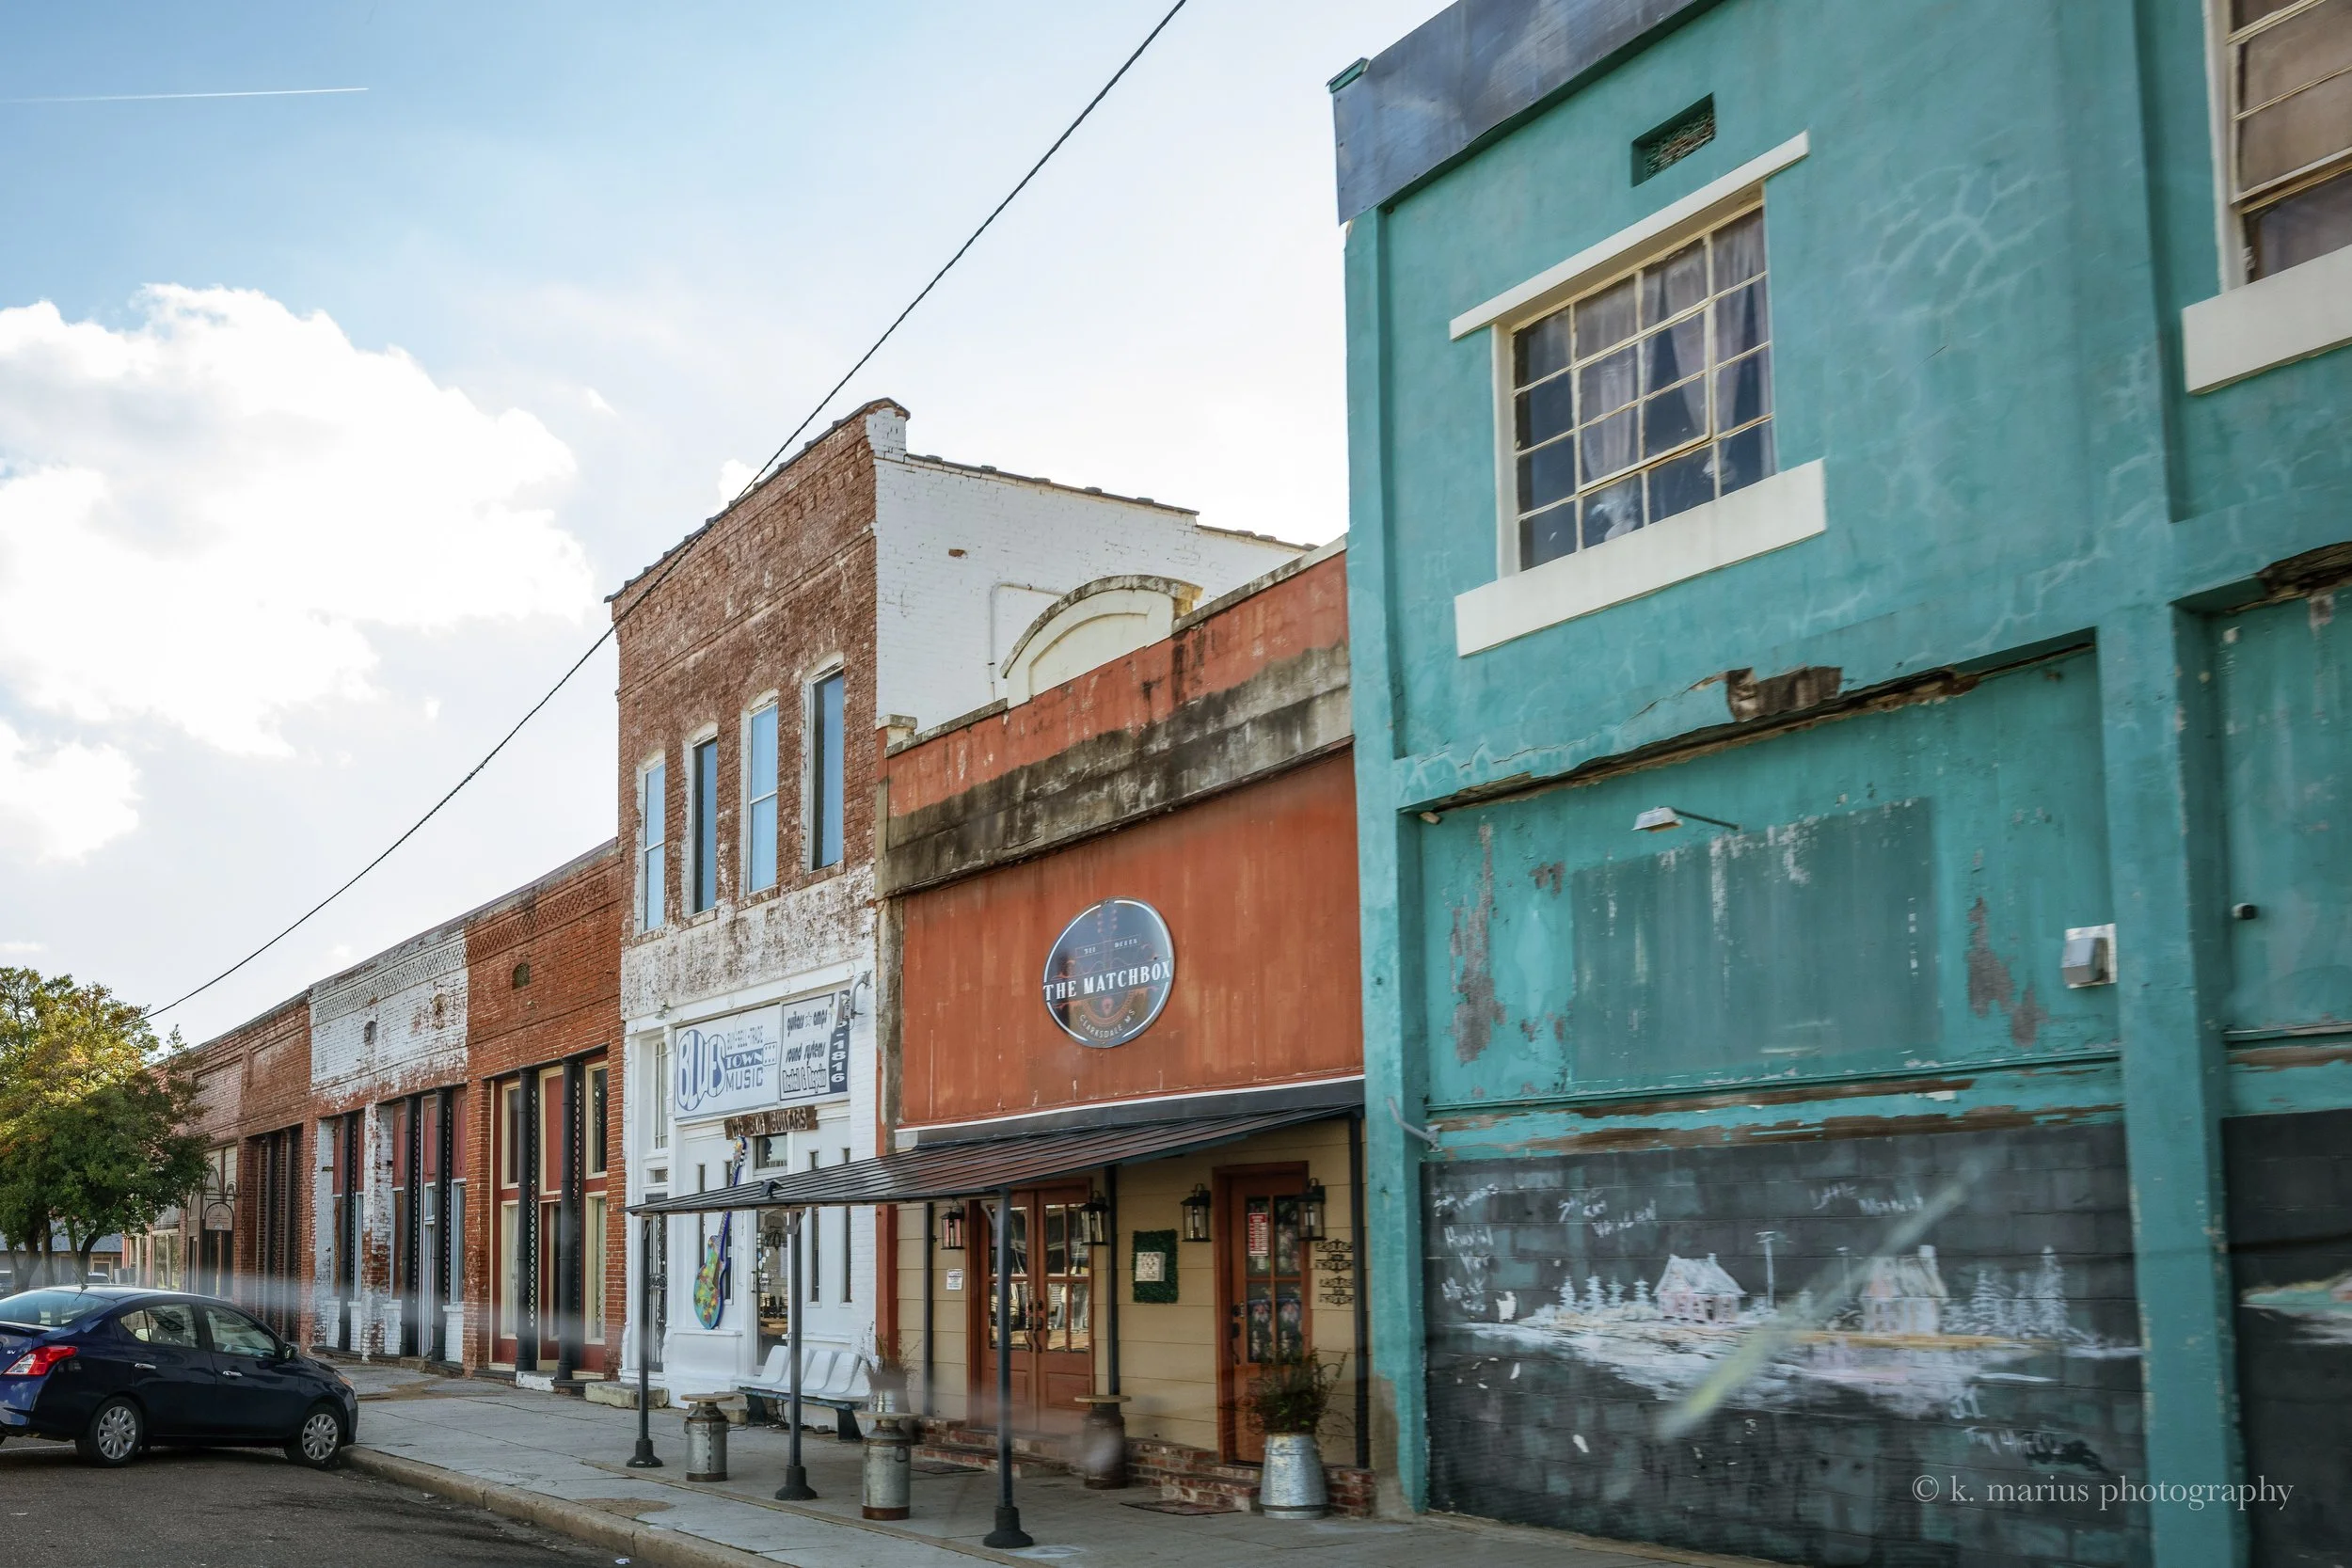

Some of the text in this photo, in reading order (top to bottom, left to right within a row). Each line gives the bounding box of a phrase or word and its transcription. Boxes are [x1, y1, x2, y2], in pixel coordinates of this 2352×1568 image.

[1043, 960, 1170, 1002] THE MATCHBOX
[1079, 1014, 1123, 1038] CLARKSDALE
[677, 1029, 726, 1111] BLUES
[725, 1052, 763, 1069] TOWN
[725, 1067, 763, 1092] MUSIC
[771, 1107, 807, 1132] GUITARS
